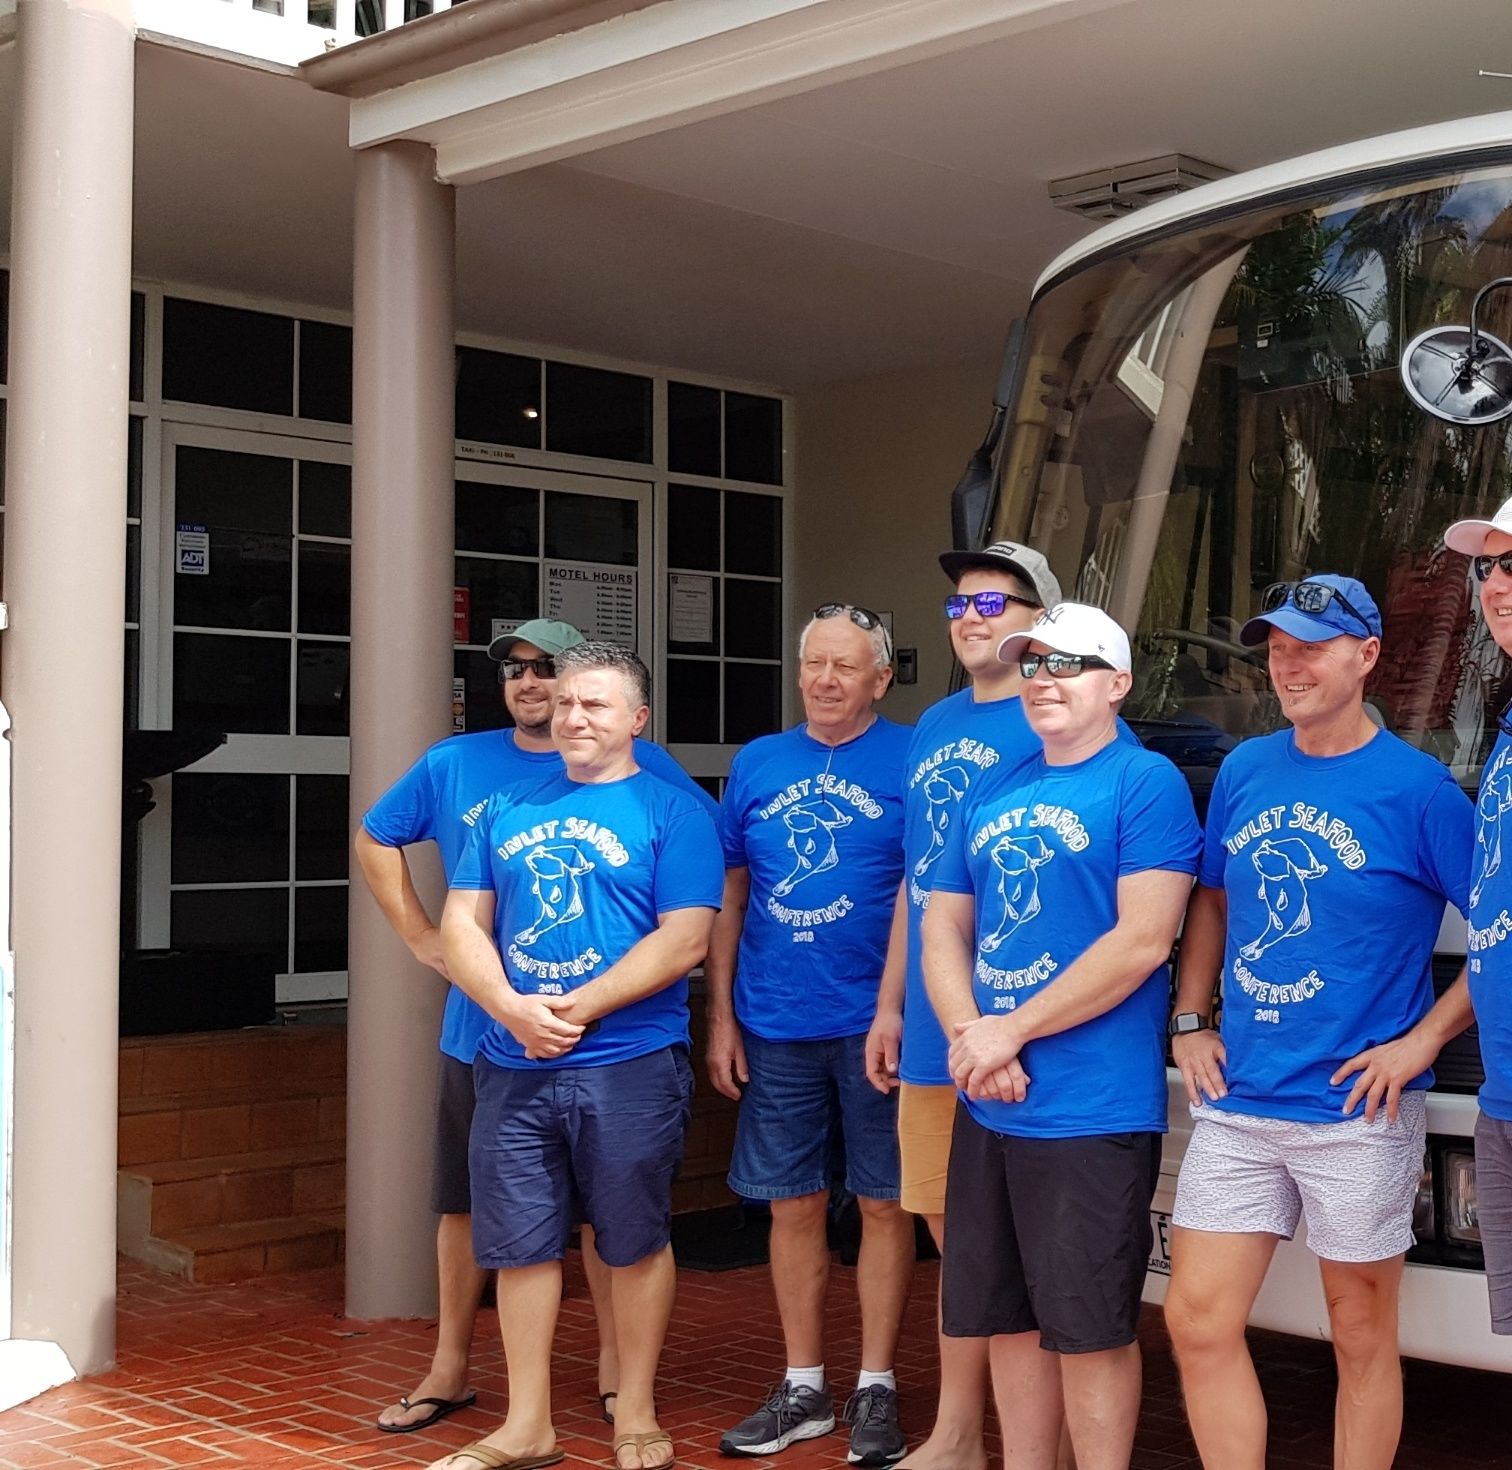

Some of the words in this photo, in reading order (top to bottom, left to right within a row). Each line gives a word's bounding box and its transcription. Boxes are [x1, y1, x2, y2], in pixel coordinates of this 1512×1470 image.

[182, 551, 204, 565] ADT
[549, 568, 588, 580] MOTEL
[593, 572, 633, 584] HOURS
[760, 778, 811, 820] INLET
[815, 773, 884, 820] SEAFOOD
[498, 819, 560, 862] INLET
[561, 816, 631, 868] SEAFOOD
[971, 807, 1029, 856] INLET
[1029, 803, 1090, 853] SEAFOOD
[1226, 805, 1286, 855] INLET
[1288, 801, 1367, 871] SEAFOOD
[767, 894, 854, 927] CONFERENCE
[792, 931, 815, 943] 2018
[508, 943, 602, 980] CONFERENCE
[538, 983, 563, 995] 2018
[1233, 957, 1325, 1004] CONFERENCE
[993, 995, 1016, 1010] 2018
[1254, 1007, 1280, 1024] 2018
